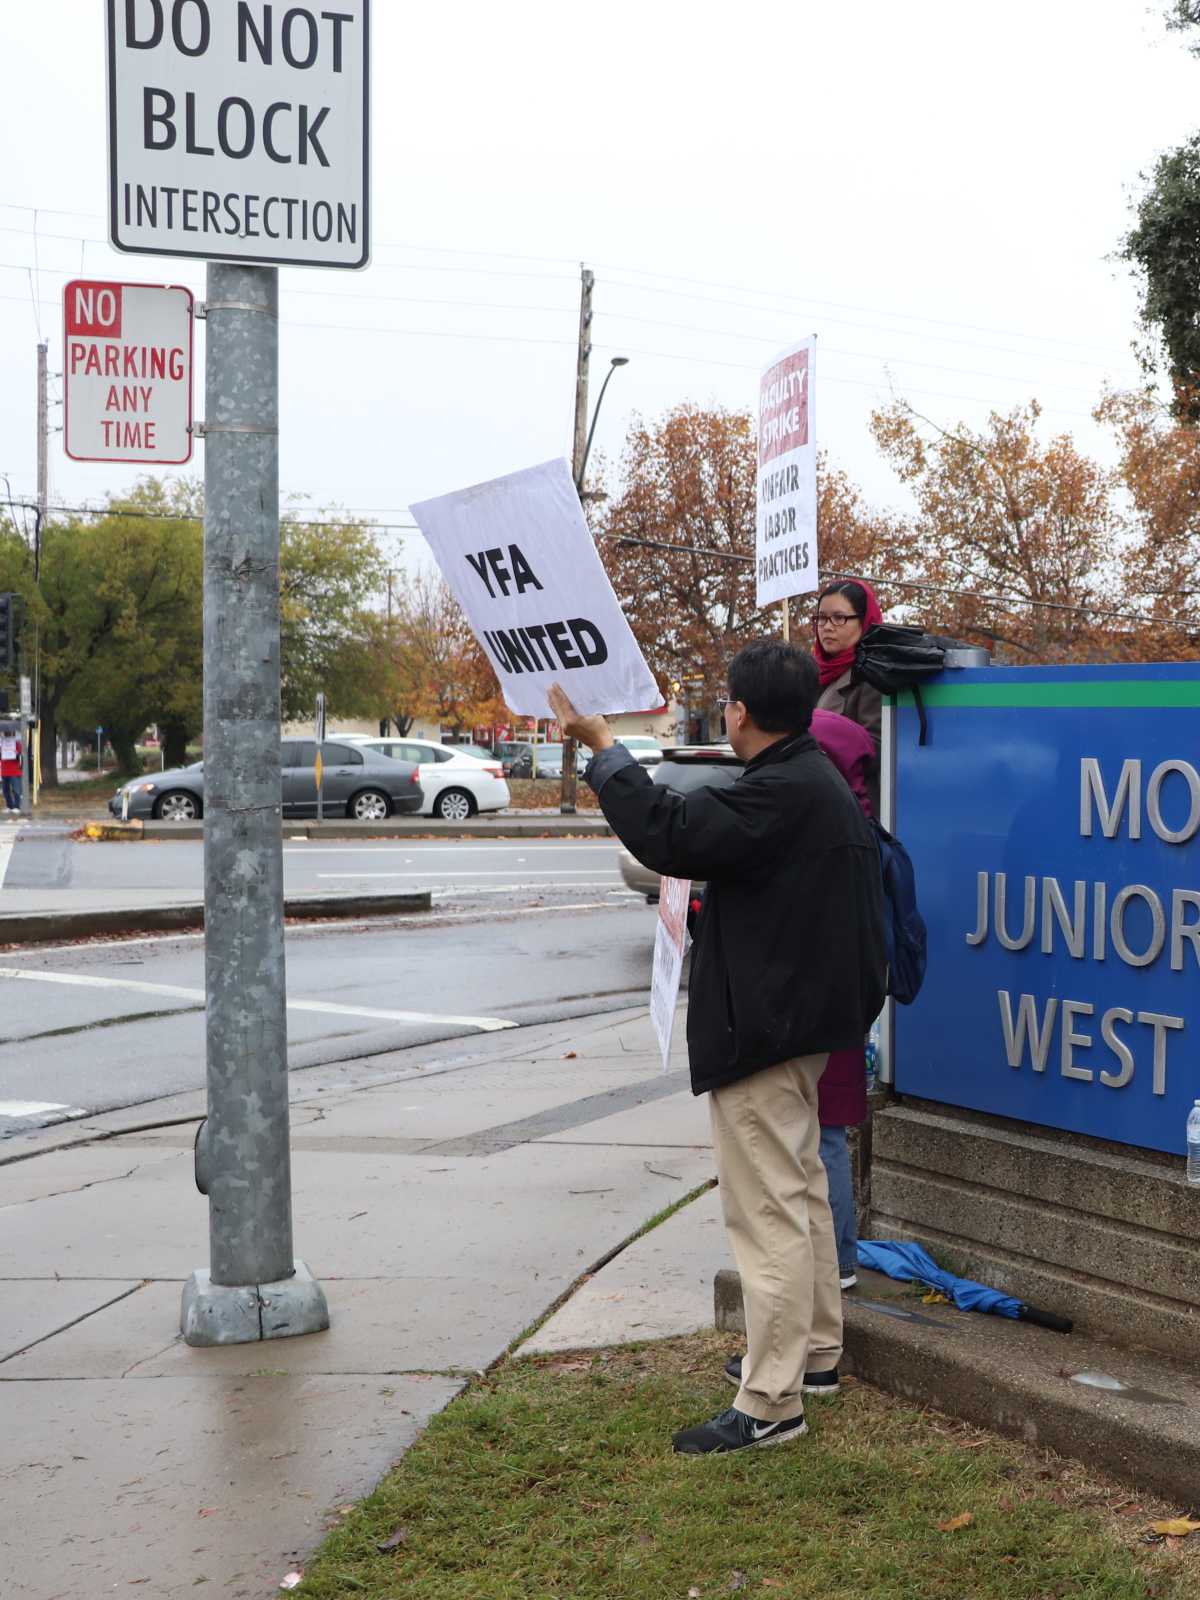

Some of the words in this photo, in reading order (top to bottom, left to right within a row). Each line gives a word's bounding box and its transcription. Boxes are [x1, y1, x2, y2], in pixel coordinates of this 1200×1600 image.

[125, 0, 211, 57] DO
[237, 0, 354, 73] NOT
[143, 86, 331, 167] BLOCK
[124, 183, 356, 244] INTERSECTION
[75, 287, 116, 326] NO
[71, 342, 185, 381] PARKING
[105, 384, 153, 413] ANY
[101, 420, 156, 449] TIME
[762, 406, 800, 449] STRIKE
[762, 464, 800, 504] UNFAIR
[764, 506, 797, 543] LABOR
[464, 543, 544, 598] YFA
[758, 541, 809, 584] PRACTICES
[483, 617, 608, 674] UNITED
[997, 989, 1185, 1096] WEST
